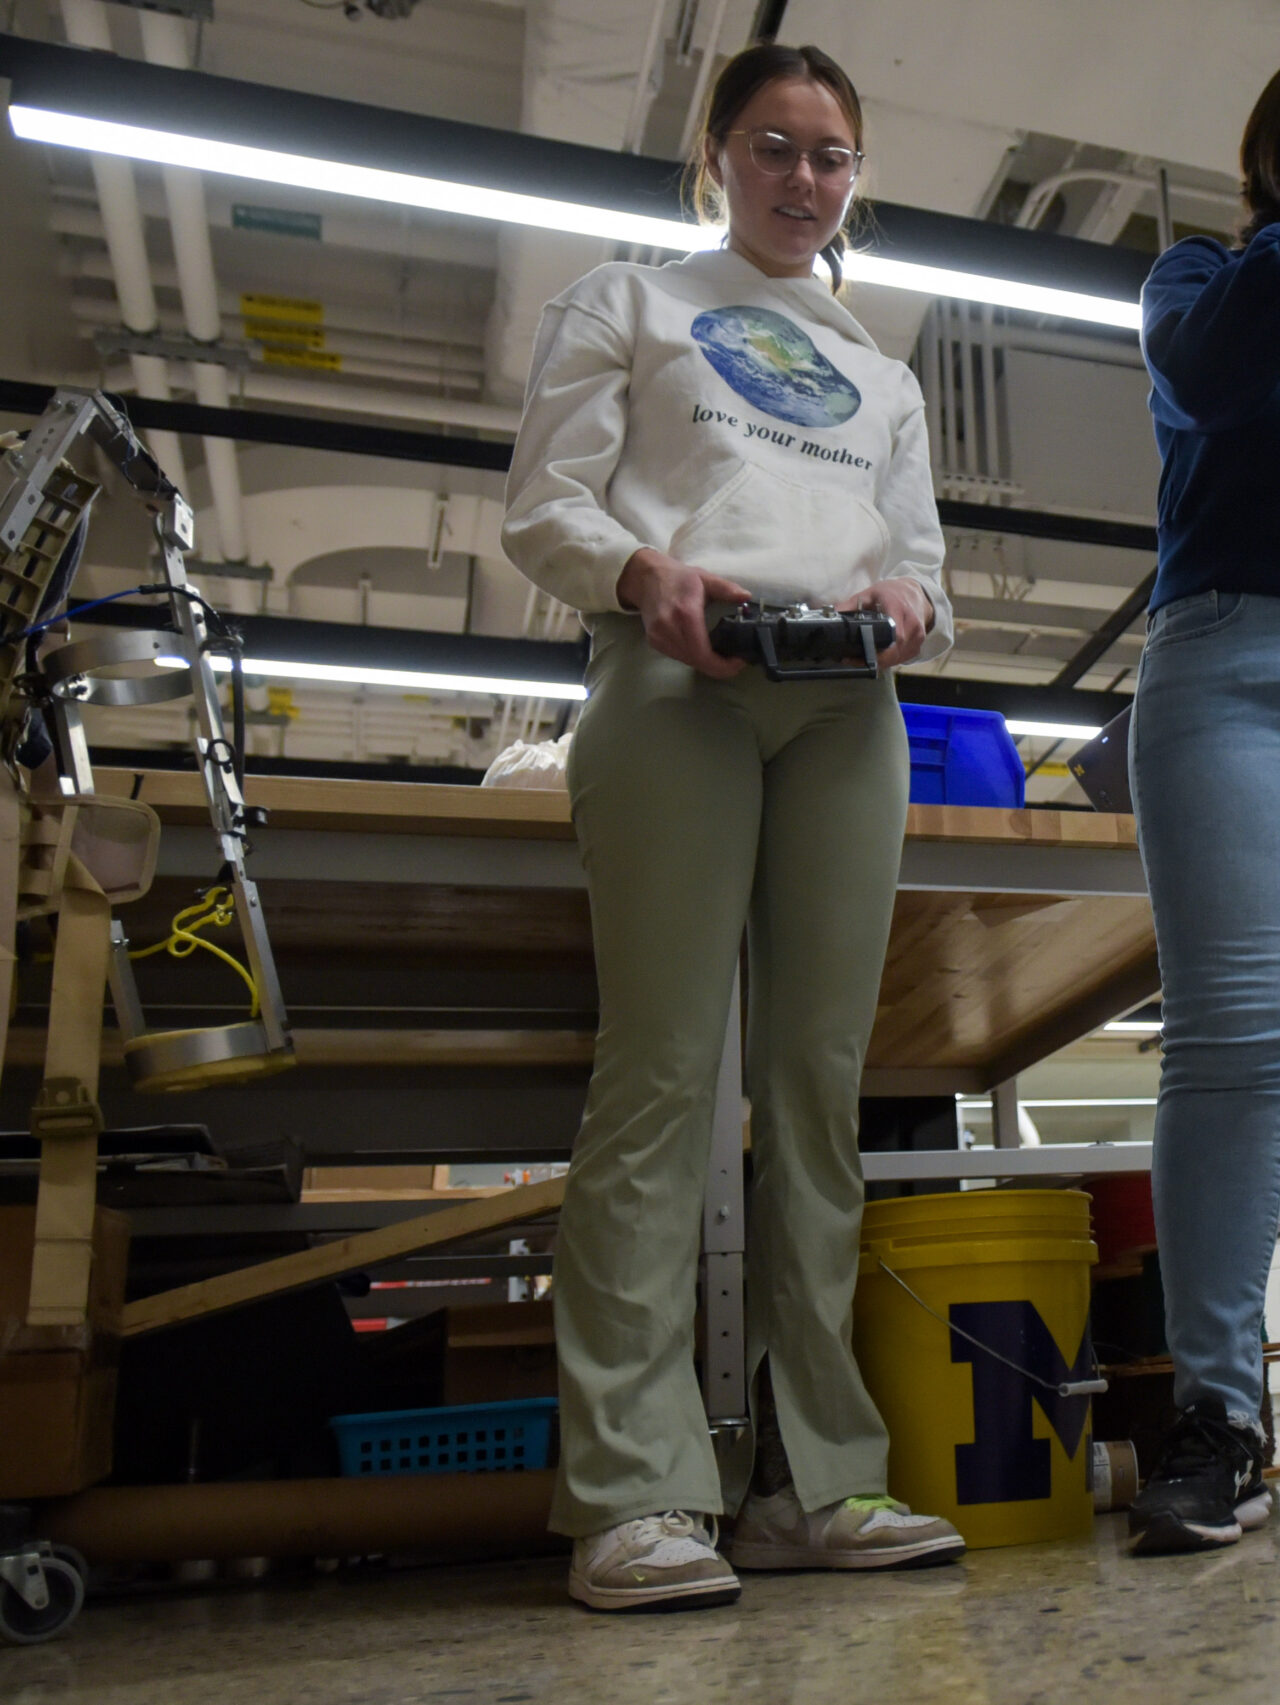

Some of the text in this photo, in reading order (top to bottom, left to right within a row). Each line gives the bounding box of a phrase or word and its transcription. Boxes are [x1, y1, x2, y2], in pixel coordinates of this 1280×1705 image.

[692, 404, 873, 471] love your mother
[948, 1300, 1095, 1506] M
